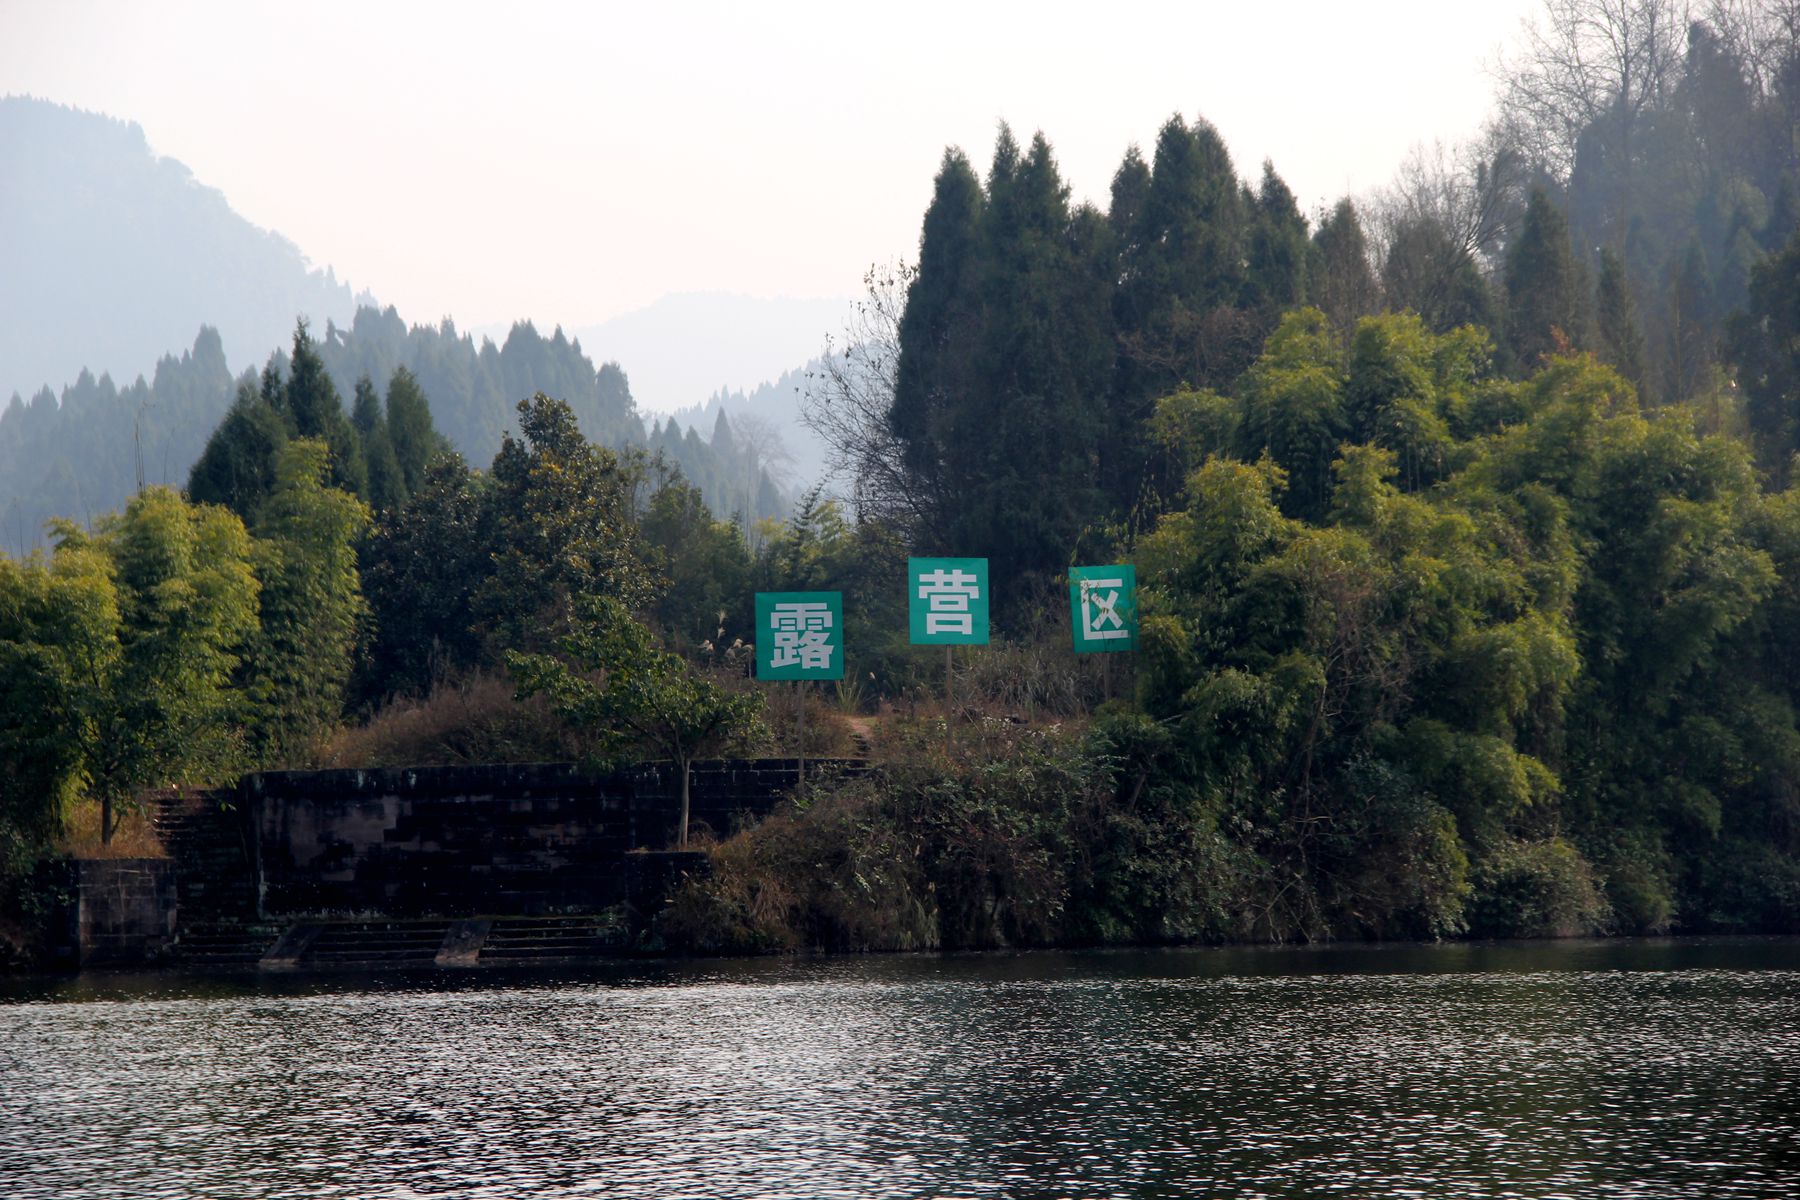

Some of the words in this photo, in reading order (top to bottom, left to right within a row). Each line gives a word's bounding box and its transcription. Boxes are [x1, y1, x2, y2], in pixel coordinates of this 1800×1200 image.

[918, 569, 979, 635] 营
[1079, 578, 1129, 641] 区
[770, 602, 834, 670] 露
